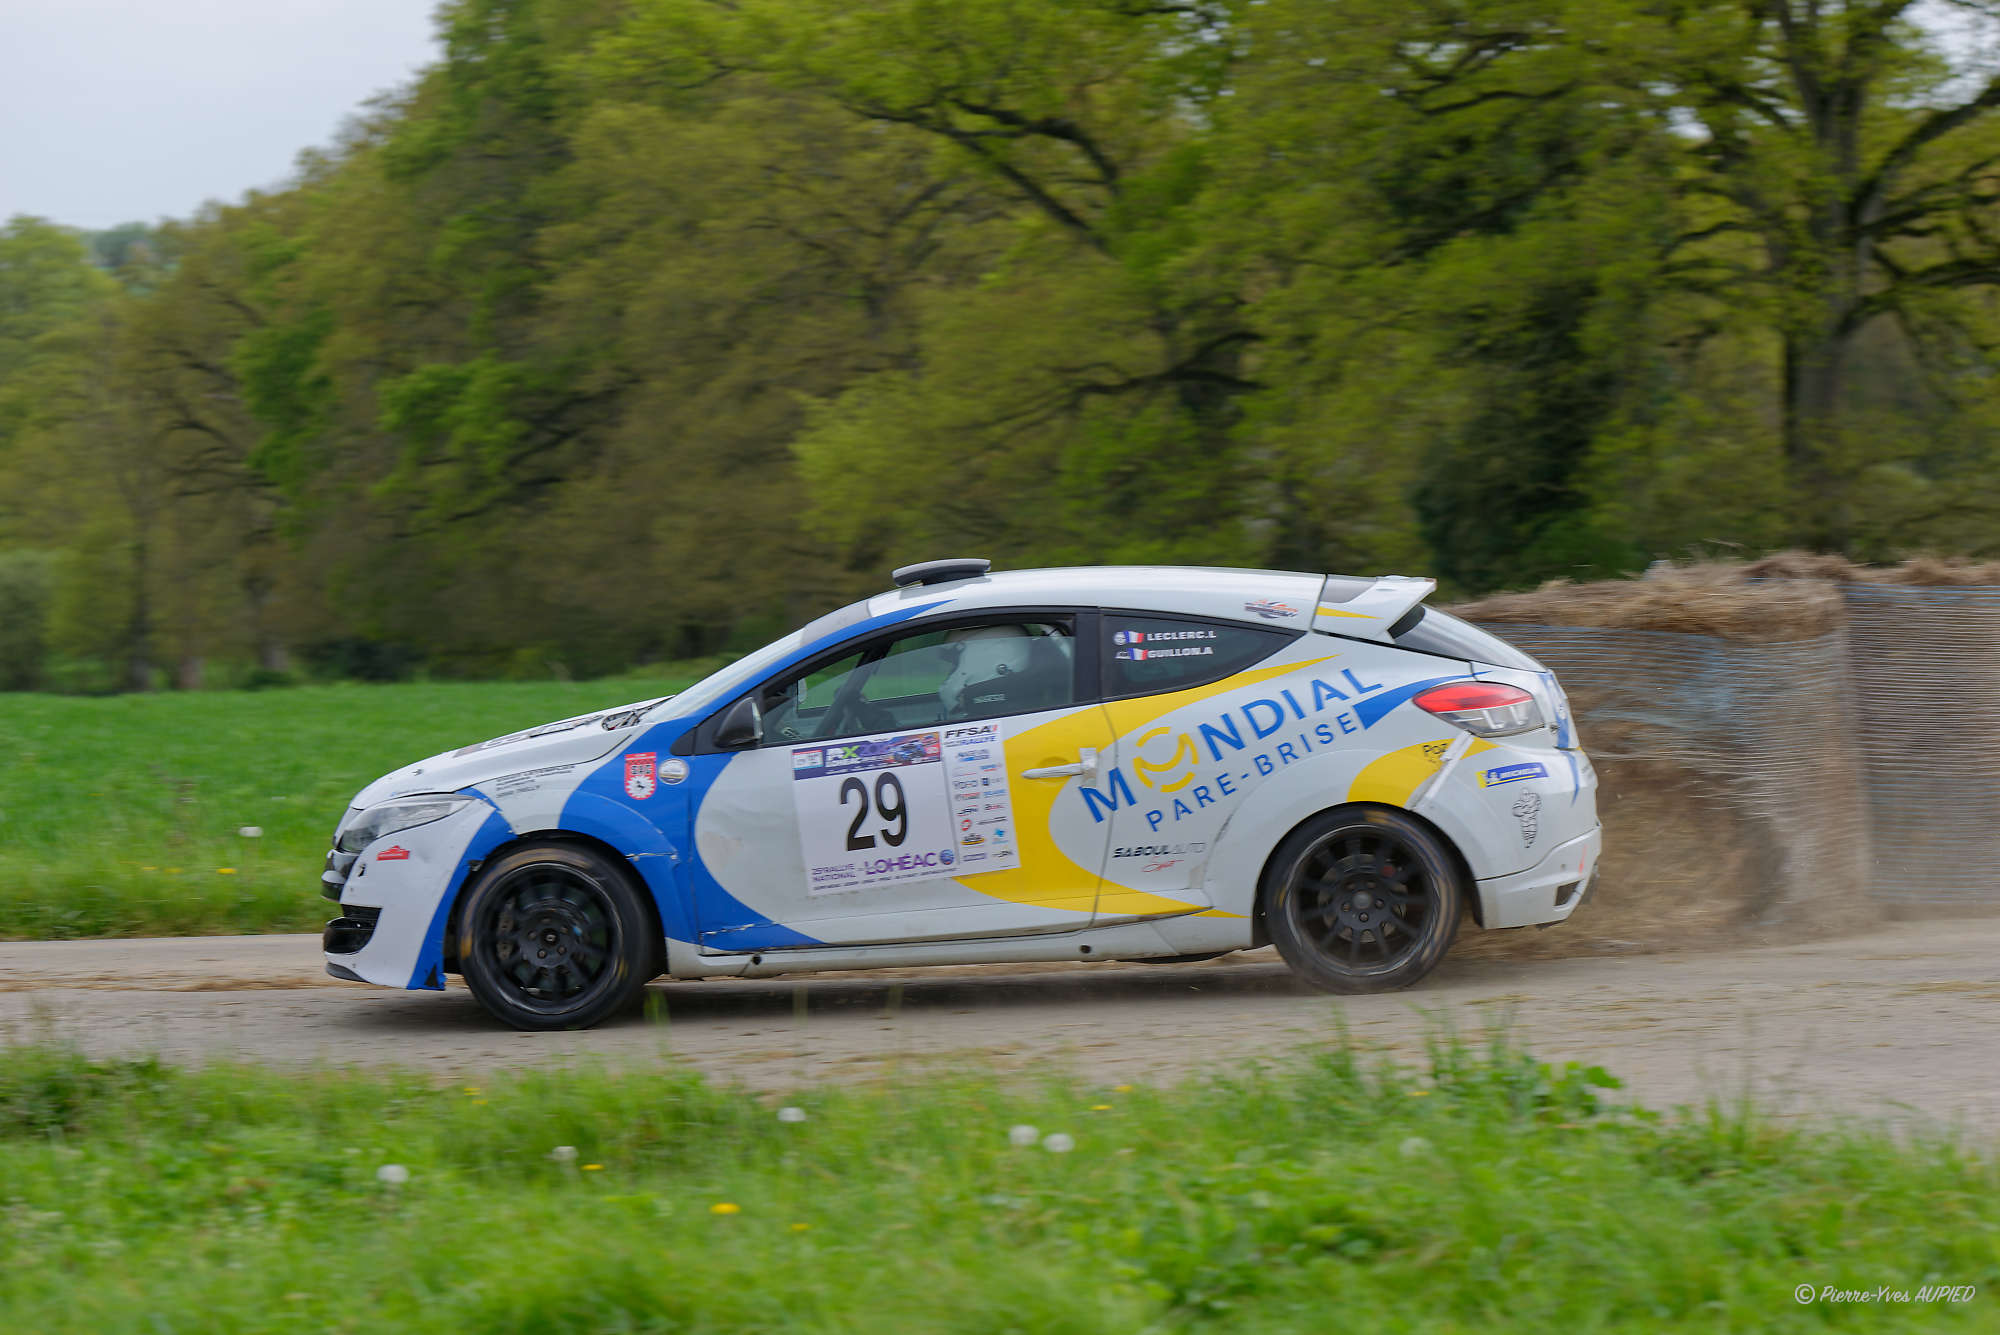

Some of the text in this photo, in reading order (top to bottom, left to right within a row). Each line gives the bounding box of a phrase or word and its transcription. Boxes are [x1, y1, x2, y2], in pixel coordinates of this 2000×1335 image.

[1146, 630, 1217, 641] LECLERC.L
[944, 725, 992, 739] FFSA
[1079, 668, 1383, 823] MONDIAL
[1145, 712, 1357, 832] PARE-BRISE
[840, 771, 907, 851] 29
[863, 851, 938, 876] LOHÉAC
